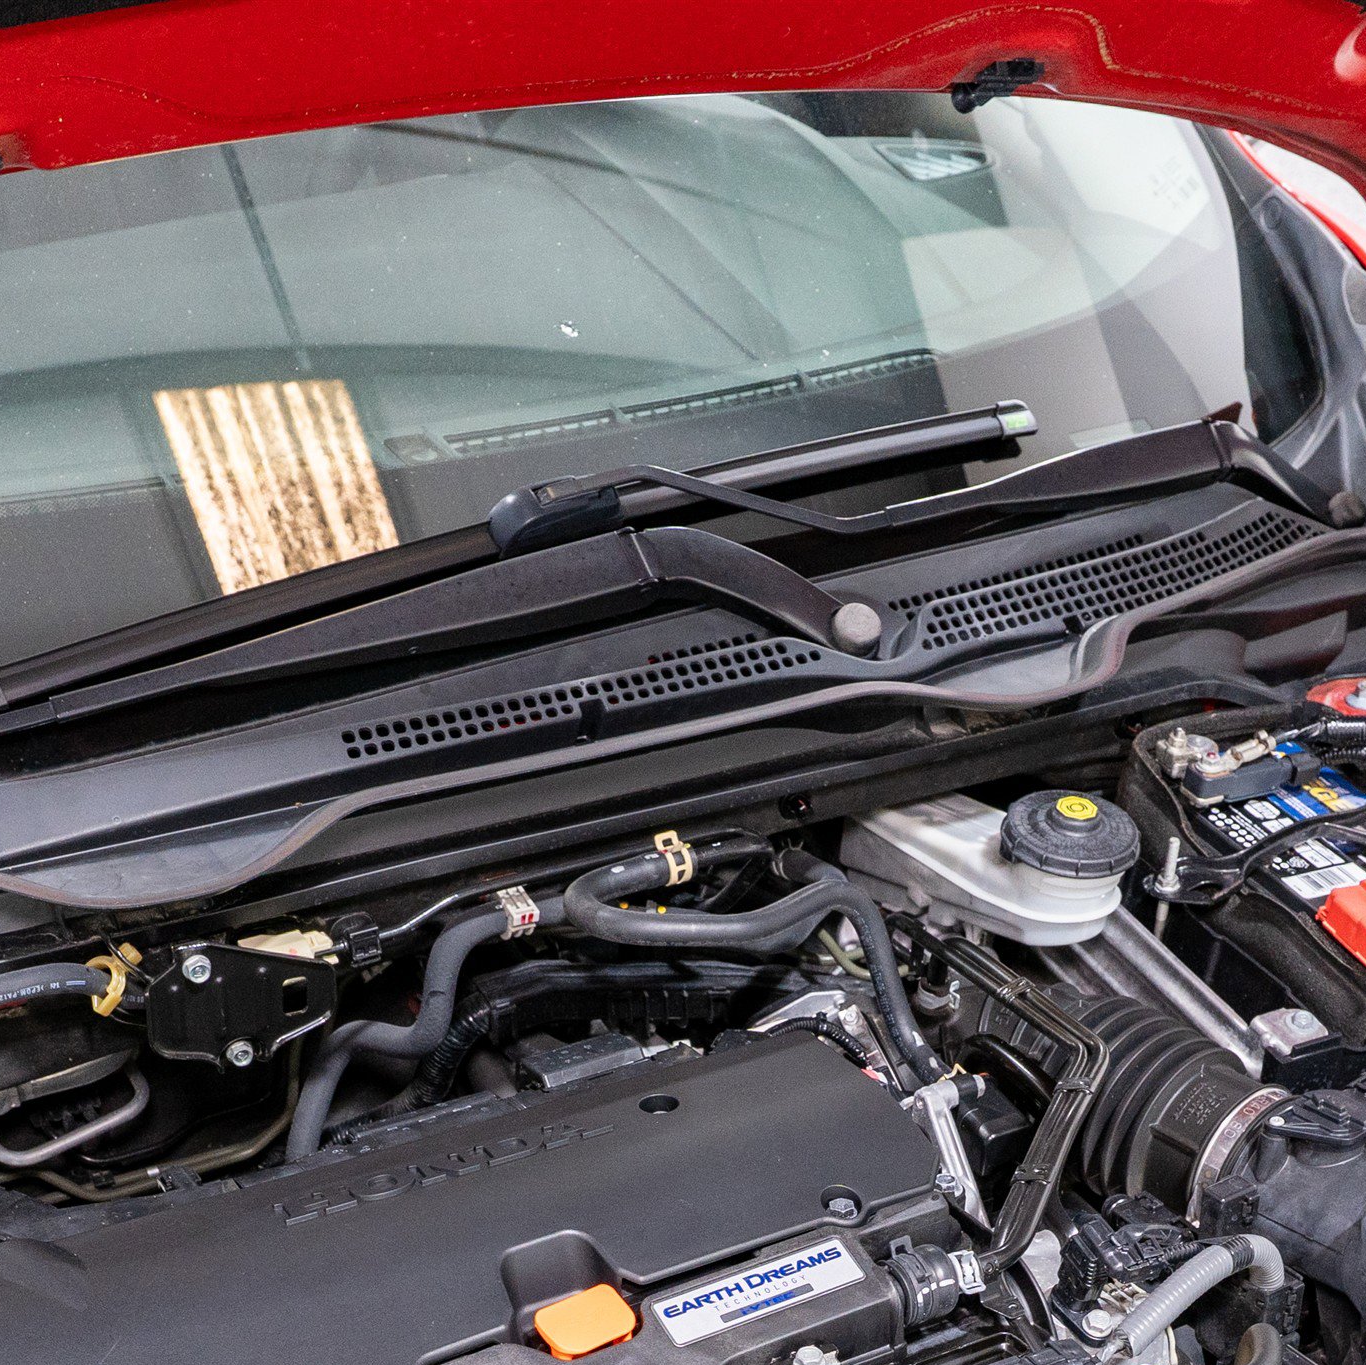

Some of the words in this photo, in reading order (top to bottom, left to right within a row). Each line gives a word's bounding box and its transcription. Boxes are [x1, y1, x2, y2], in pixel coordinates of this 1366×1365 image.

[273, 1123, 614, 1226] HONDA
[663, 1282, 744, 1320] EARTH
[743, 1246, 842, 1290] DREAMS
[714, 1274, 807, 1311] TECHNOLOGY
